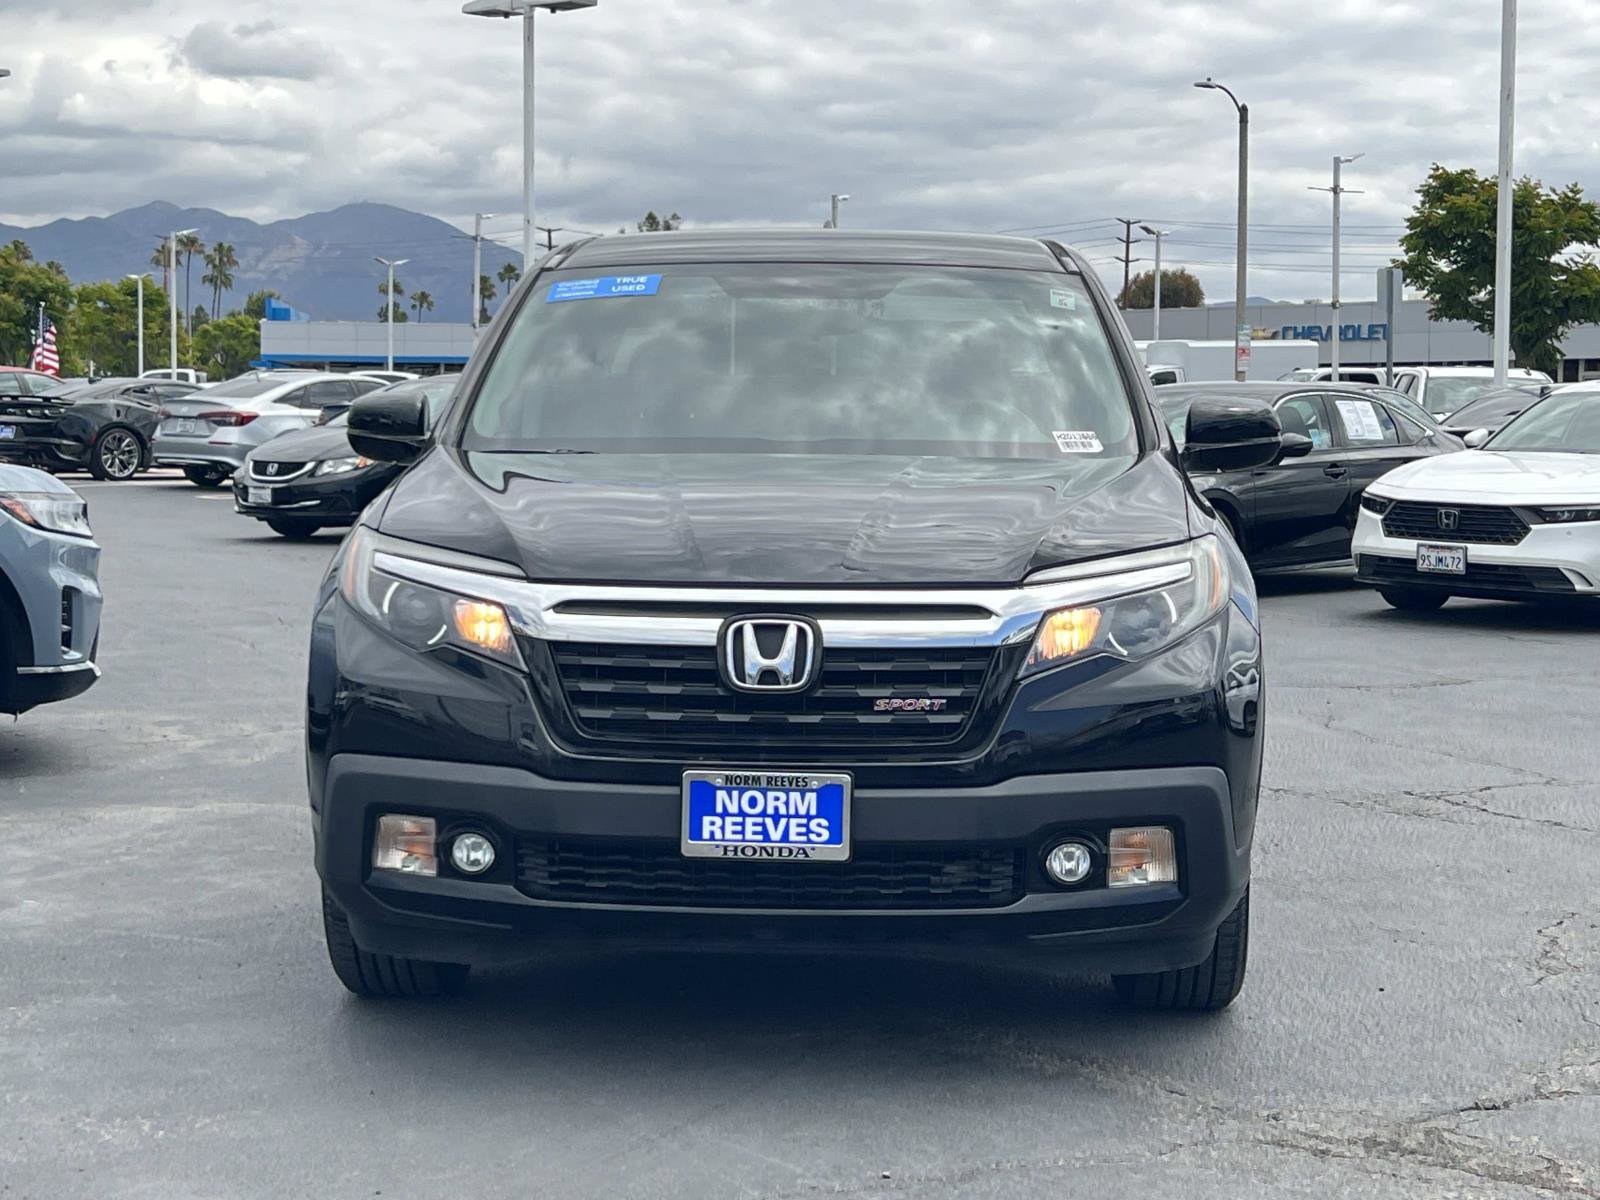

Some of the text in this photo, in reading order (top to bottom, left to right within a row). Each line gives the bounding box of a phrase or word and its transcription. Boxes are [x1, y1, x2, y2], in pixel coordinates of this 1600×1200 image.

[616, 276, 648, 284] TRUE
[611, 284, 645, 292] USED
[873, 698, 947, 711] SPORT
[725, 775, 808, 788] NORM REEVES
[715, 790, 817, 816] NORM
[702, 816, 830, 842] REEVES
[722, 845, 810, 858] HONDA
